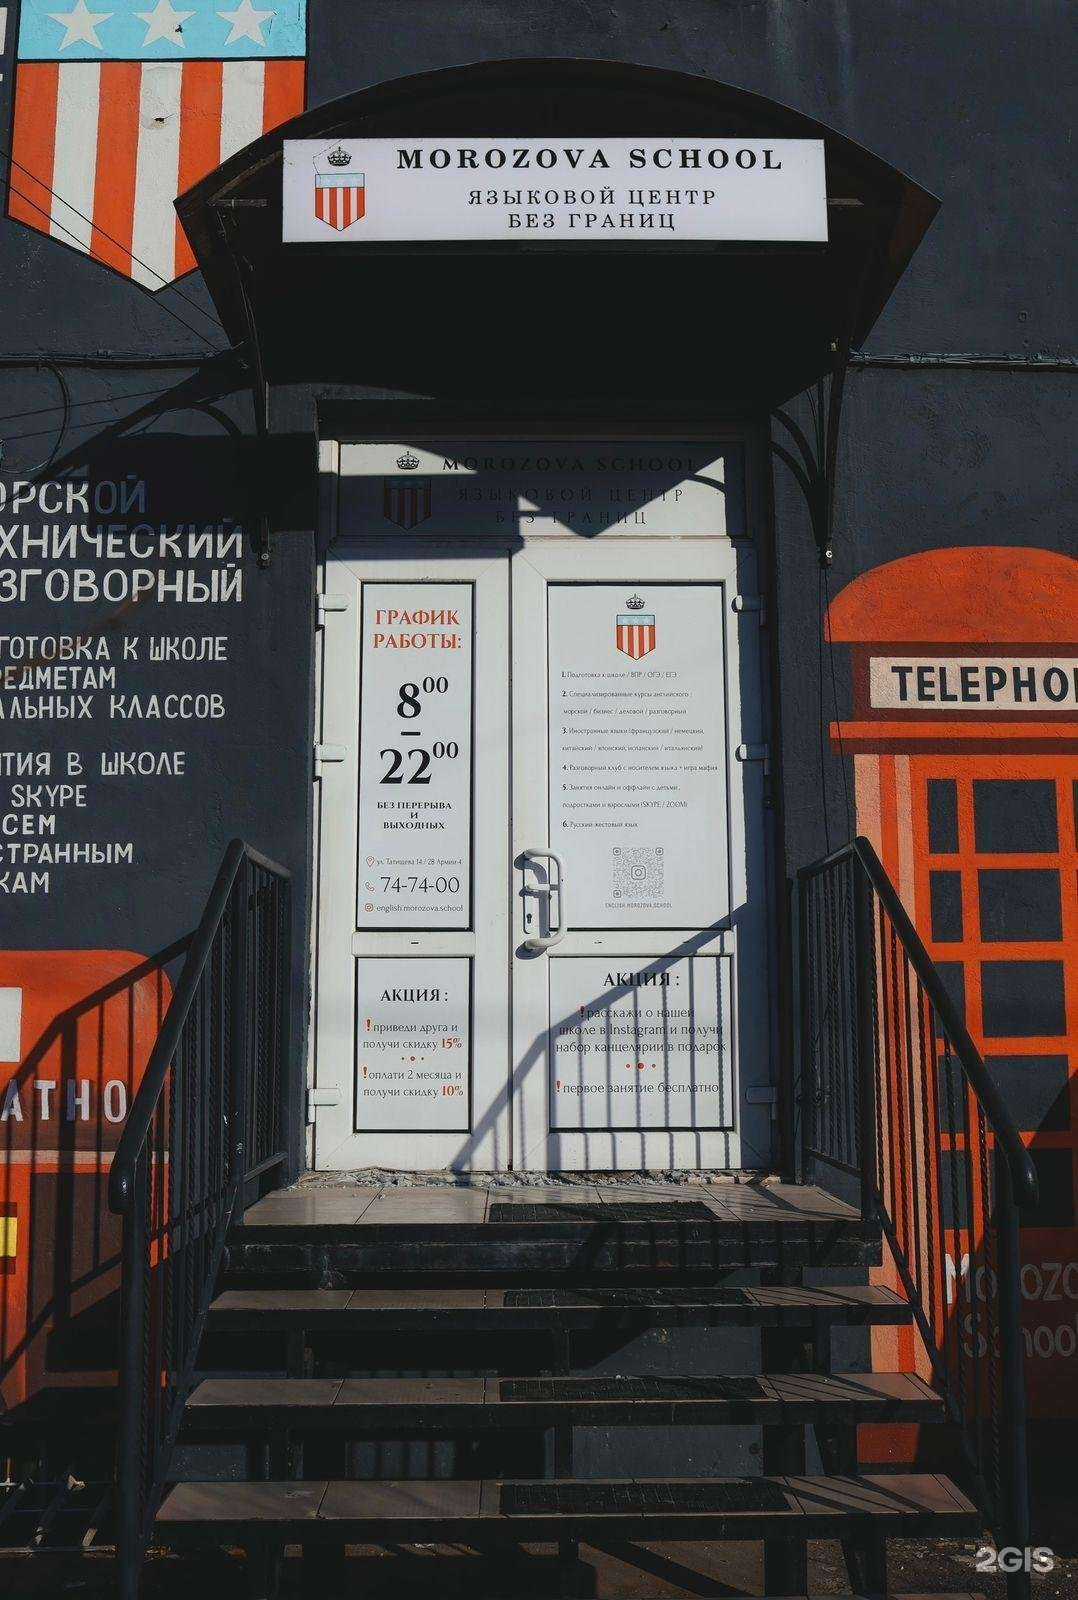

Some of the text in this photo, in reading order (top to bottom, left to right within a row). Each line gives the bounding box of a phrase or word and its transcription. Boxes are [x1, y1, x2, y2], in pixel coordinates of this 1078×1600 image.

[396, 148, 782, 170] MOROZOVA SCHOOL
[467, 187, 716, 207] ЯЗЫКОВОЙ ЦЕНТР
[507, 213, 676, 231] БЕЗ ГРАНИЦ
[442, 457, 700, 472] MOROZOVA SCHOOL
[456, 486, 684, 504] ЯЗЫКОВОЙ ЦЕНТР
[495, 511, 649, 525] БЕЗ ГРАНИЦ
[0, 563, 243, 603] ЗГОВОРНЫЙ
[375, 609, 461, 625] ГРАФИК
[123, 636, 139, 661] К
[149, 636, 228, 661] ШКОЛЕ
[373, 633, 463, 649] РАБОТЫ:
[0, 666, 116, 690] ЕДМЕТАМ
[891, 666, 1078, 703] TELEPHO
[0, 694, 226, 719] ЛЬНЫХ КЛАССОВ
[67, 752, 83, 776] В
[101, 752, 186, 776] ШКОЛЕ
[11, 784, 88, 808] SKYPE
[377, 801, 453, 810] БЕЗ ПЕРЕРЫВА
[410, 811, 419, 819] И
[383, 821, 446, 830] ВЫХОДНЫХ
[380, 876, 461, 893] 74-74-00
[645, 1010, 654, 1018] о
[656, 1007, 695, 1018] нашей
[419, 1024, 448, 1034] друга
[451, 1024, 458, 1032] и
[559, 1026, 597, 1035] школе
[600, 1027, 607, 1035] в
[670, 1027, 678, 1035] и
[681, 1026, 724, 1038] получи
[363, 1037, 463, 1051] получи скидку 15%
[556, 1041, 727, 1055] набор канцелярии в подарок
[407, 1069, 414, 1079] 2
[416, 1073, 452, 1081] месяца
[363, 1085, 464, 1099] получи скидку 10%
[608, 1083, 654, 1093] занятие
[657, 1081, 719, 1094] бесплатно
[1, 1078, 128, 1123] АТНО
